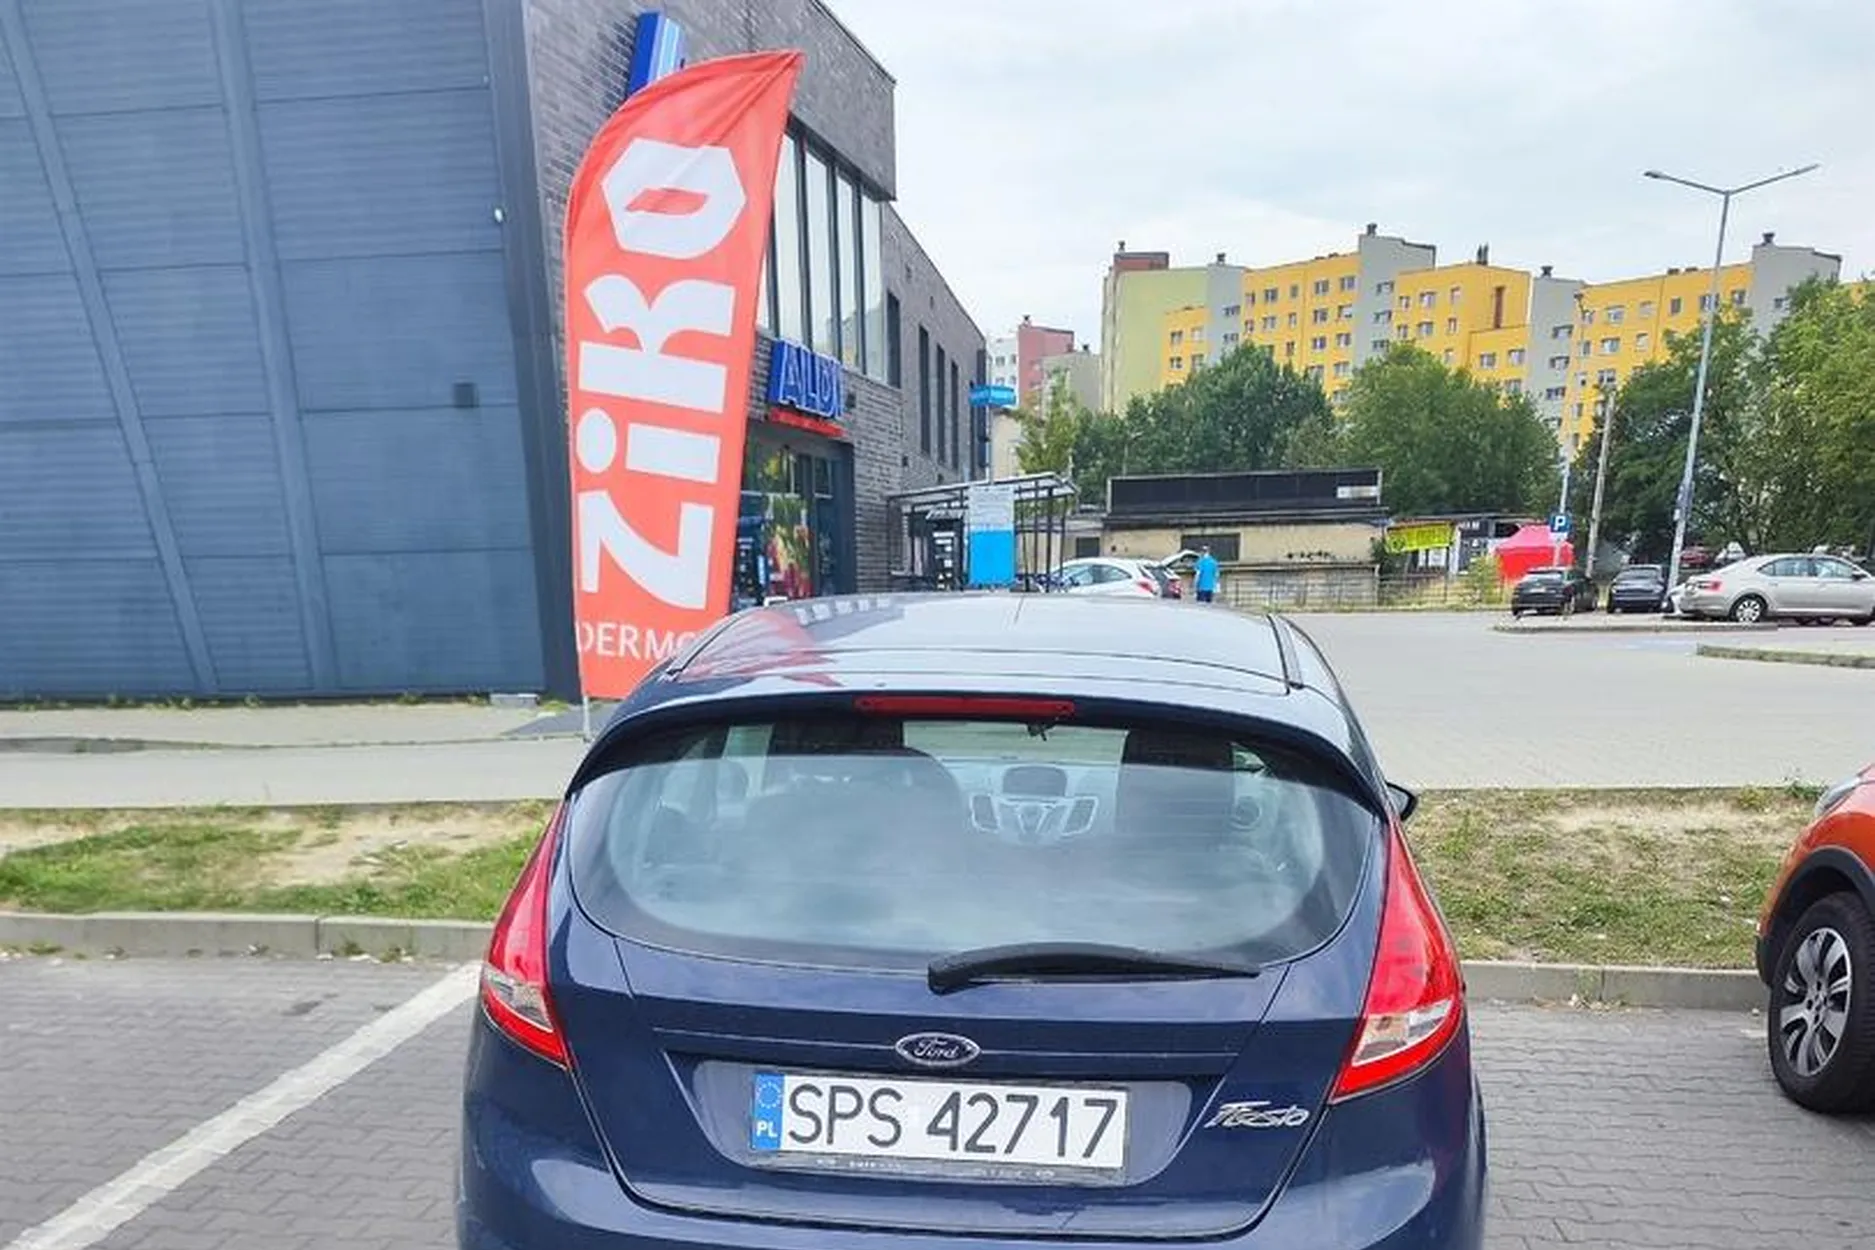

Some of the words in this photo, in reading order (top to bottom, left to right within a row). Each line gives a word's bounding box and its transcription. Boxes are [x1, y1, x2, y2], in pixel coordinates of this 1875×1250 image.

[778, 342, 845, 420] ALDI
[1554, 515, 1566, 531] P
[913, 1038, 960, 1059] Ford
[788, 1083, 903, 1148] SPS
[926, 1091, 1118, 1158] 42717
[1203, 1100, 1310, 1129] Fiesta
[756, 1120, 778, 1139] PL
